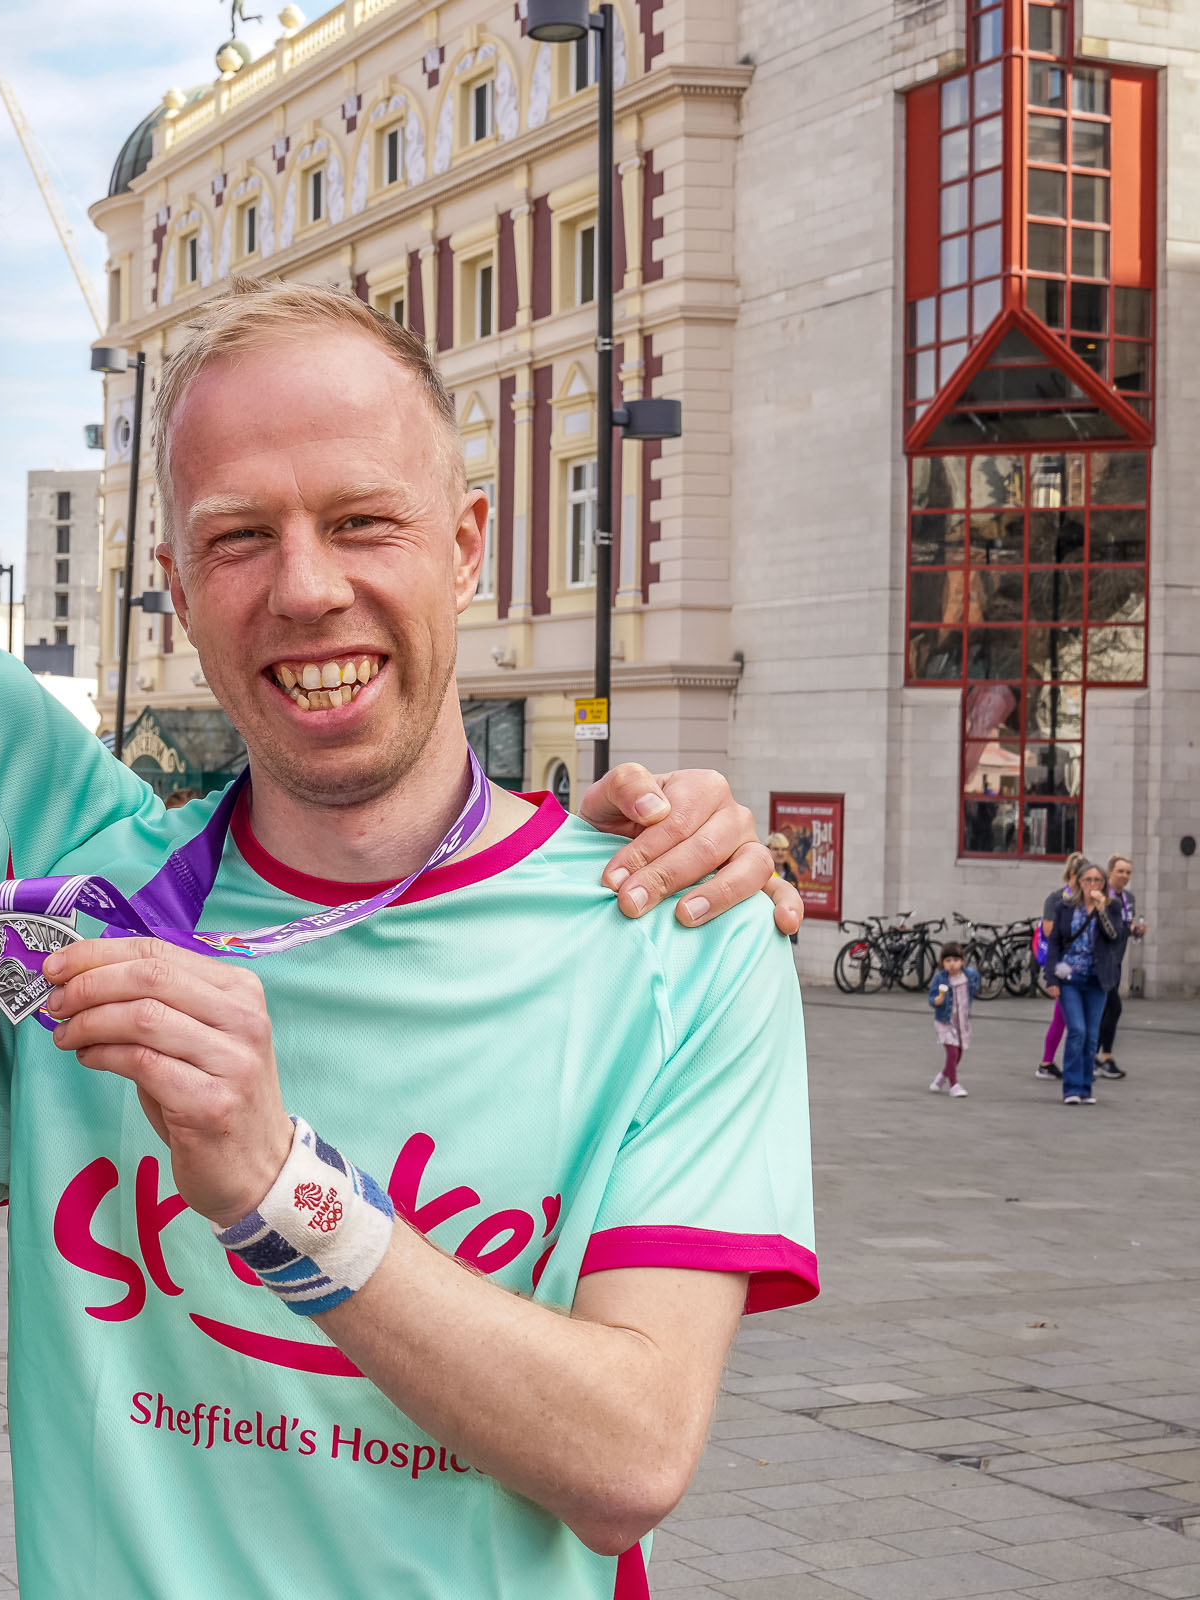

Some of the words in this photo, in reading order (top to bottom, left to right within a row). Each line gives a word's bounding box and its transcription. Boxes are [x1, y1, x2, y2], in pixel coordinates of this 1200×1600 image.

[30, 981, 48, 999] HALF
[307, 1201, 331, 1230] TEAM
[326, 1187, 338, 1204] GB
[130, 1391, 317, 1456] Sheffield's
[331, 1424, 485, 1480] Hospic
